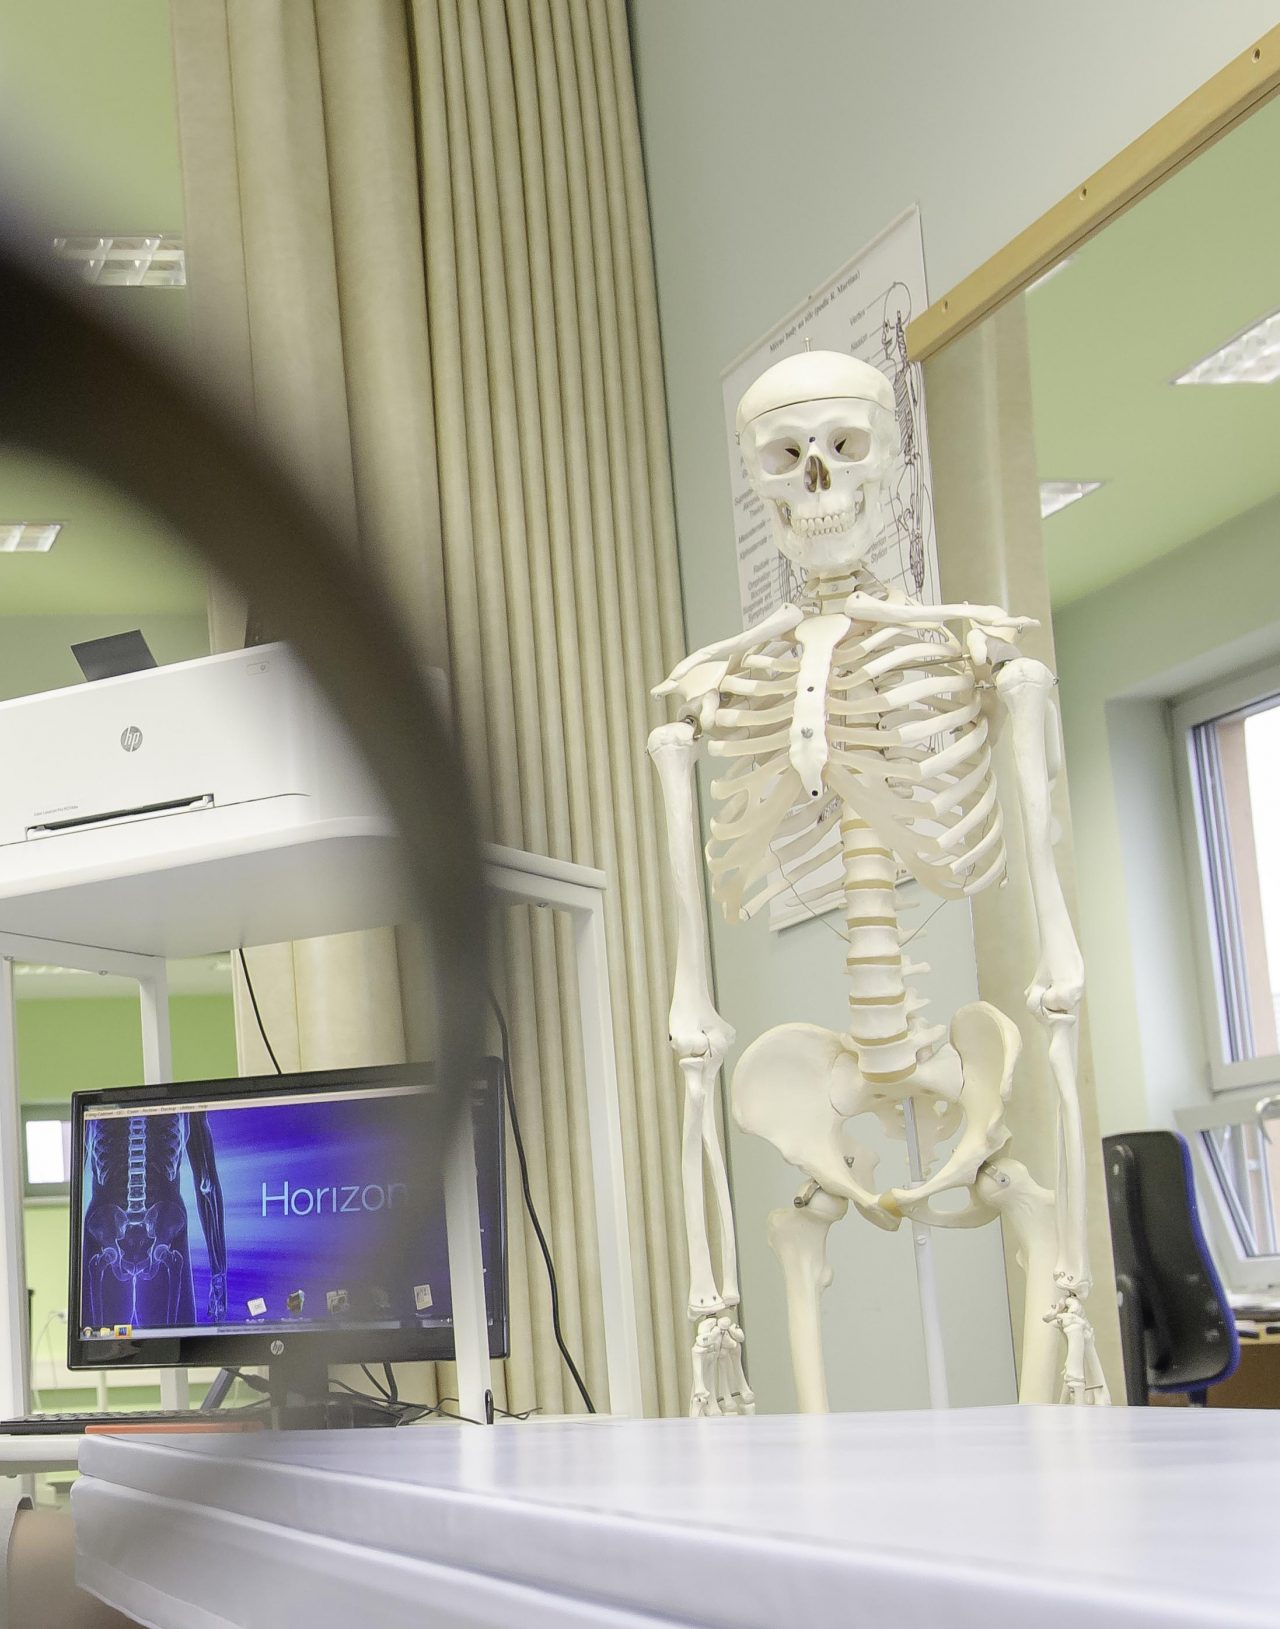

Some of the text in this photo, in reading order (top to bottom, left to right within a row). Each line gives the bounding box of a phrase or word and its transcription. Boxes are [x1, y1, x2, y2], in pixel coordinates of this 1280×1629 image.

[120, 726, 143, 752] hp
[261, 1180, 408, 1217] Horizon
[270, 1340, 284, 1356] hp
